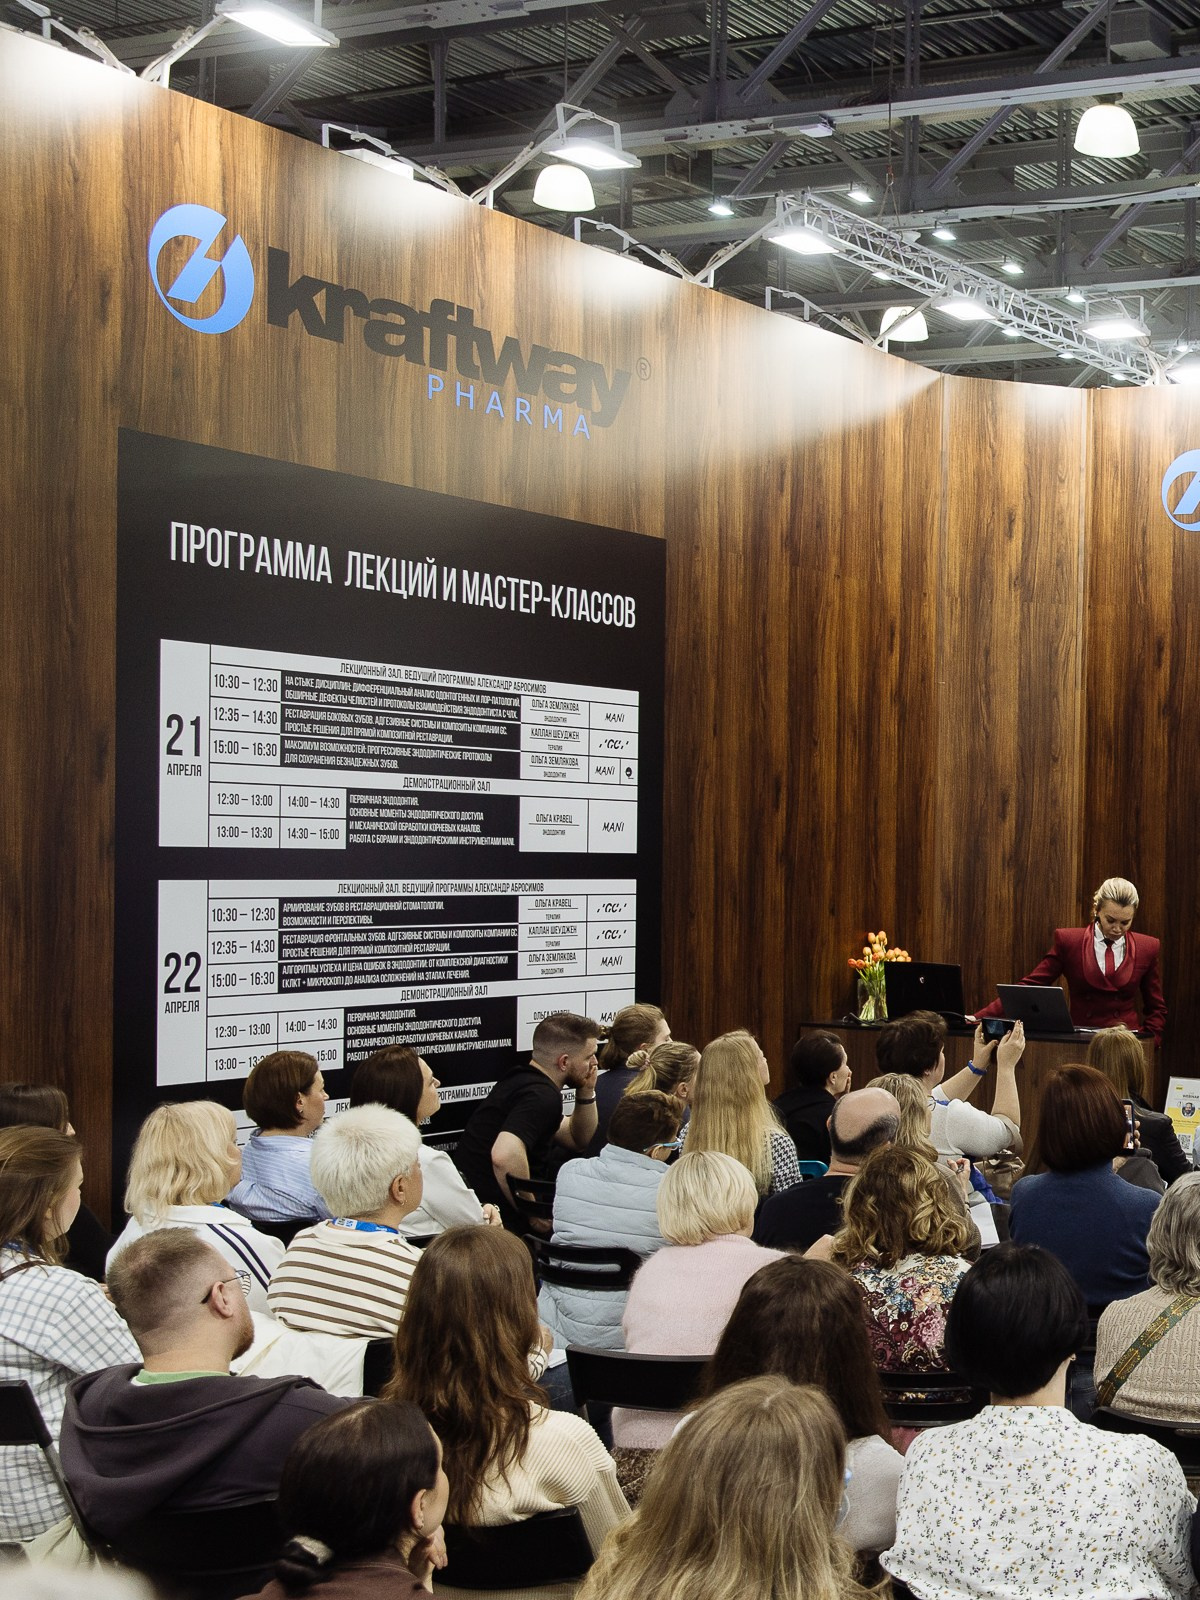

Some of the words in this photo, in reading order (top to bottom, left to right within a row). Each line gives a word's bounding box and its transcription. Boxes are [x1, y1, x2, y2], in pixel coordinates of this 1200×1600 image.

[267, 245, 632, 428] kraftway
[428, 374, 591, 439] PHARMA
[171, 521, 332, 584] ПРОГРАММА
[344, 550, 437, 600] ЛЕКЦИЙ
[443, 566, 456, 602] И
[462, 569, 636, 629] МАСТЕР-КЛАССОВ
[214, 673, 240, 689] 10:30
[253, 677, 278, 692] 12:30
[340, 663, 386, 677] ЛЕКЦИОННЫЙ
[388, 667, 403, 679] ЗАЛ.
[405, 669, 436, 683] ВЕДУЩИЙ
[438, 673, 476, 686] ПРОГРАММЫ
[477, 678, 512, 691] АЛЕКСАНДР
[513, 682, 547, 693] АБРОСИМОВ
[532, 699, 549, 709] ОЛЬГА
[549, 701, 580, 712] ЗЕМЛЯКОВА
[214, 707, 239, 722] 12:35
[253, 711, 278, 724] 14:30
[605, 713, 624, 723] MANI
[166, 714, 201, 757] 21
[531, 728, 552, 738] КАПЛАН
[214, 740, 239, 754] 15:00
[253, 742, 277, 757] 16:30
[298, 754, 336, 765] СОХРАНЕНИЯ
[531, 755, 547, 765] ОЛЬГА
[548, 756, 579, 766] ЗЕМЛЯКОВА
[167, 763, 202, 777] АПРЕЛЯ
[595, 766, 615, 775] MANI
[403, 777, 476, 791] ДЕМОНСТРАЦИОННЫЙ
[477, 780, 490, 791] ЗАЛ
[217, 793, 240, 806] 12:30
[251, 794, 273, 807] 13:00
[288, 796, 309, 808] 14:00
[320, 797, 340, 809] 14:30
[536, 813, 552, 823] ОЛЬГА
[553, 814, 573, 824] КРАВЕЦ
[217, 826, 240, 838] 13:00
[251, 826, 273, 839] 13:30
[288, 827, 309, 839] 14:30
[319, 828, 340, 840] 15:00
[602, 822, 624, 832] MANI
[338, 882, 384, 894] ЛЕКЦИОННЫЙ
[386, 884, 400, 893] ЗАЛ.
[402, 882, 434, 894] ВЕДУЩИЙ
[435, 883, 474, 893] ПРОГРАММЫ
[475, 882, 510, 893] АЛЕКСАНДР
[511, 883, 544, 893] АБРОСИМОВ
[535, 898, 551, 908] ОЛЬГА
[552, 898, 572, 908] КРАВЕЦ
[212, 907, 238, 922] 10:30
[251, 907, 276, 921] 12:30
[528, 926, 549, 935] КАПЛАН
[212, 940, 237, 954] 12:35
[251, 939, 275, 953] 14:30
[528, 953, 545, 963] ОЛЬГА
[546, 952, 576, 962] ЗЕМЛЯКОВА
[600, 955, 622, 966] MANI
[164, 951, 201, 994] 22
[212, 973, 237, 988] 15:00
[250, 971, 275, 985] 16:30
[401, 987, 473, 1001] ДЕМОНСТРАЦИОННЫЙ
[474, 985, 488, 996] ЗАЛ
[165, 1000, 200, 1014] АПРЕЛЯ
[600, 1011, 616, 1022] MAN
[215, 1025, 238, 1038] 12:30
[249, 1023, 271, 1036] 13:00
[285, 1021, 306, 1033] 14:00
[317, 1018, 338, 1030] 14:30
[317, 1049, 337, 1061] 15:00
[214, 1058, 237, 1071] 13:00
